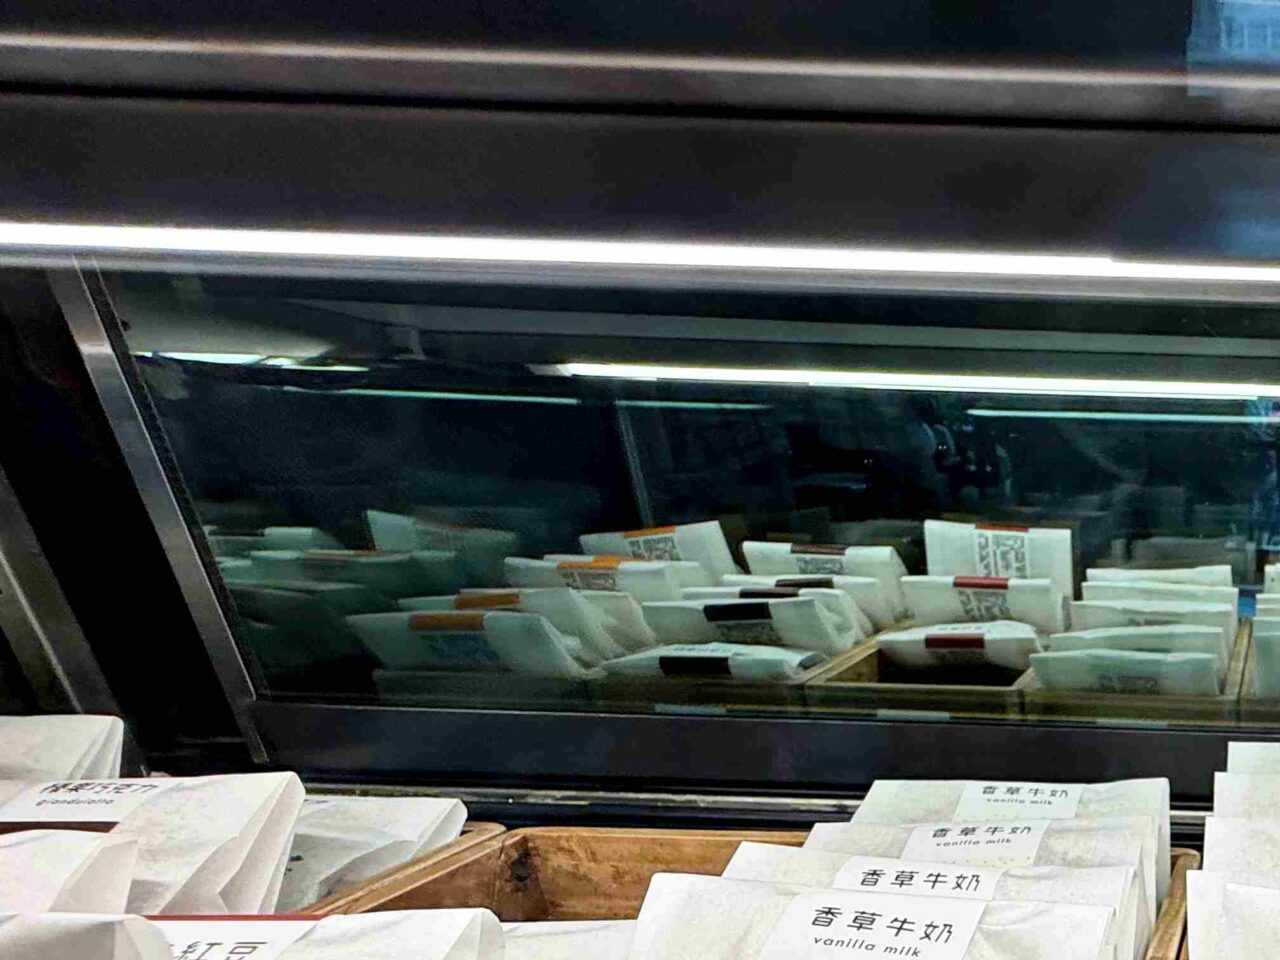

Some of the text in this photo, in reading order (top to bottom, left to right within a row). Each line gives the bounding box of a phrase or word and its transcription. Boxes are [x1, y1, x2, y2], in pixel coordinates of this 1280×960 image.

[982, 785, 1069, 798] 香草牛奶
[932, 825, 1032, 838] 香草牛奶
[936, 839, 980, 847] vanilla
[860, 869, 981, 892] 香草牛奶
[811, 906, 954, 944] 香草牛奶
[813, 936, 922, 957] vanilla milk
